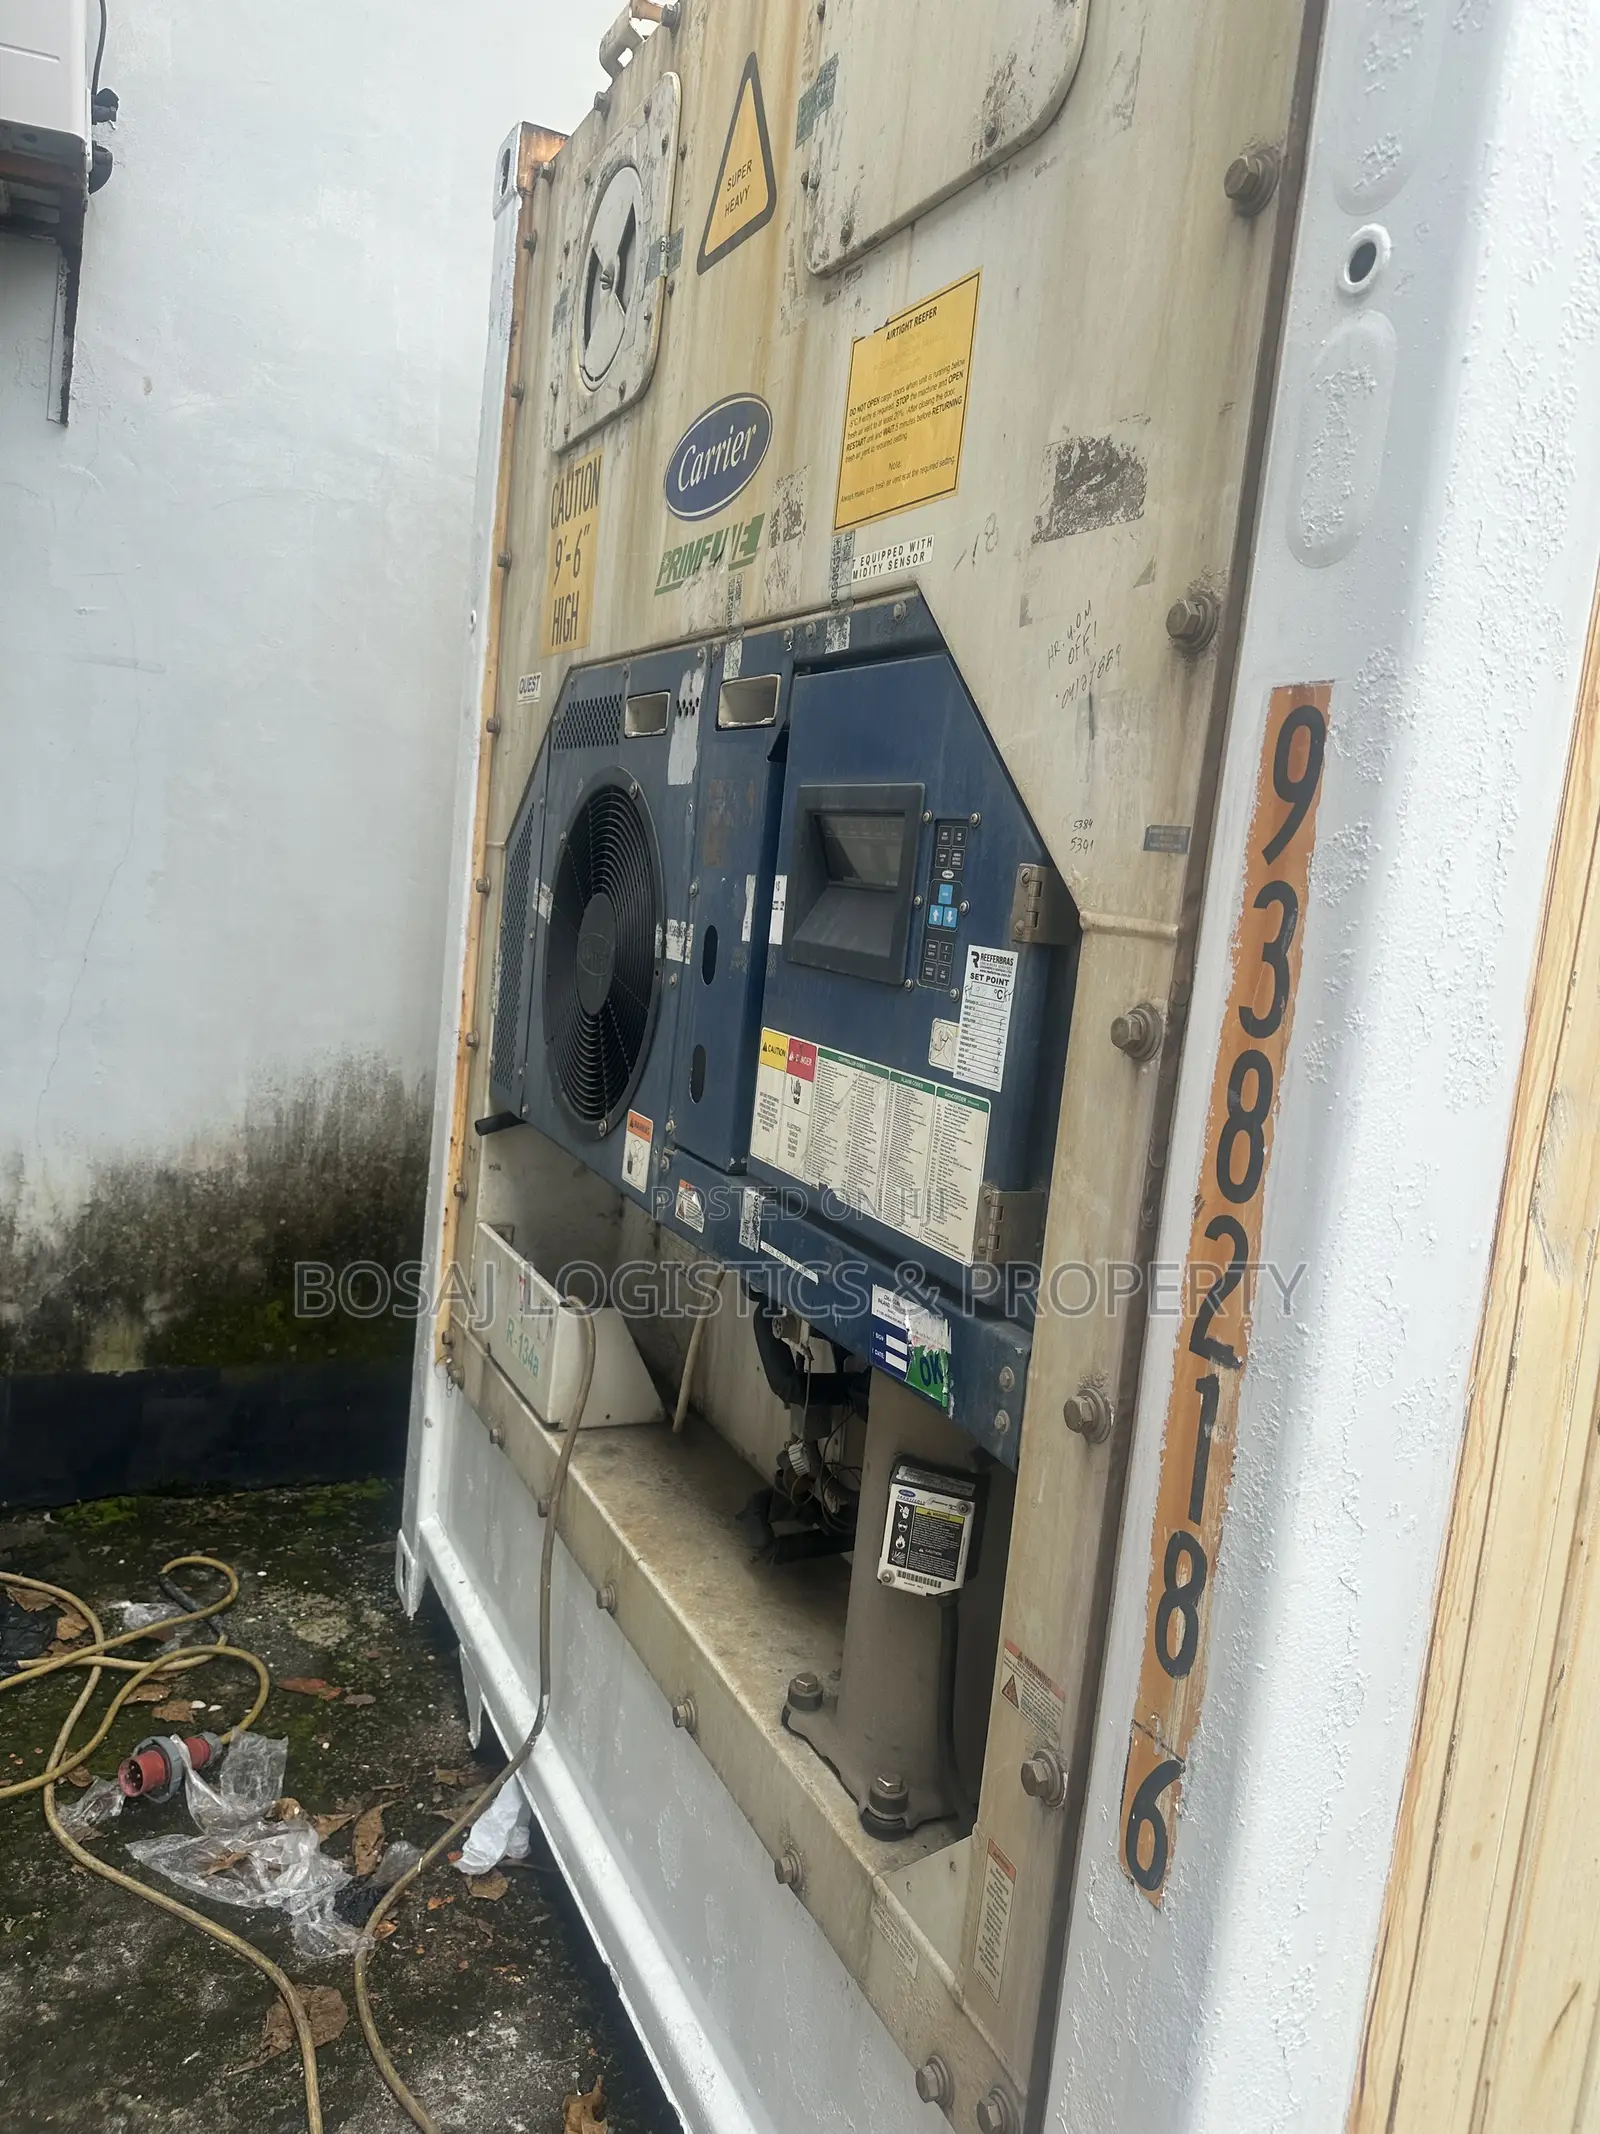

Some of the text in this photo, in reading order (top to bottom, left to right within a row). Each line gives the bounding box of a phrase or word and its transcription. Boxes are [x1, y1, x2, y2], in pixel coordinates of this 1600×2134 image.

[727, 159, 752, 192] SUPER
[724, 184, 750, 217] HEAVY
[885, 304, 937, 342] AIRTIGHT REEFER
[895, 393, 909, 408] STOP
[948, 368, 964, 384] OPEN
[849, 407, 856, 417] DO
[856, 402, 866, 414] NOT
[866, 395, 880, 409] OPEN
[846, 436, 865, 452] RESTART
[882, 424, 894, 437] WAIT
[931, 395, 962, 416] RETURNING
[678, 423, 757, 492] Carrier
[551, 455, 602, 530] CAUTION
[852, 562, 884, 580] MIDITY
[888, 551, 926, 571] SENSOR
[860, 545, 904, 567] EQUIPPED
[909, 536, 934, 552] WITH
[552, 590, 580, 646] HIGH
[519, 674, 541, 695] QUEST
[980, 952, 1013, 966] REEFERBRAS
[969, 972, 1009, 986] SET POINT
[768, 1044, 786, 1057] CAUTION
[794, 1052, 812, 1066] DNGER
[506, 1317, 540, 1379] R-134a
[919, 1351, 944, 1387] OK
